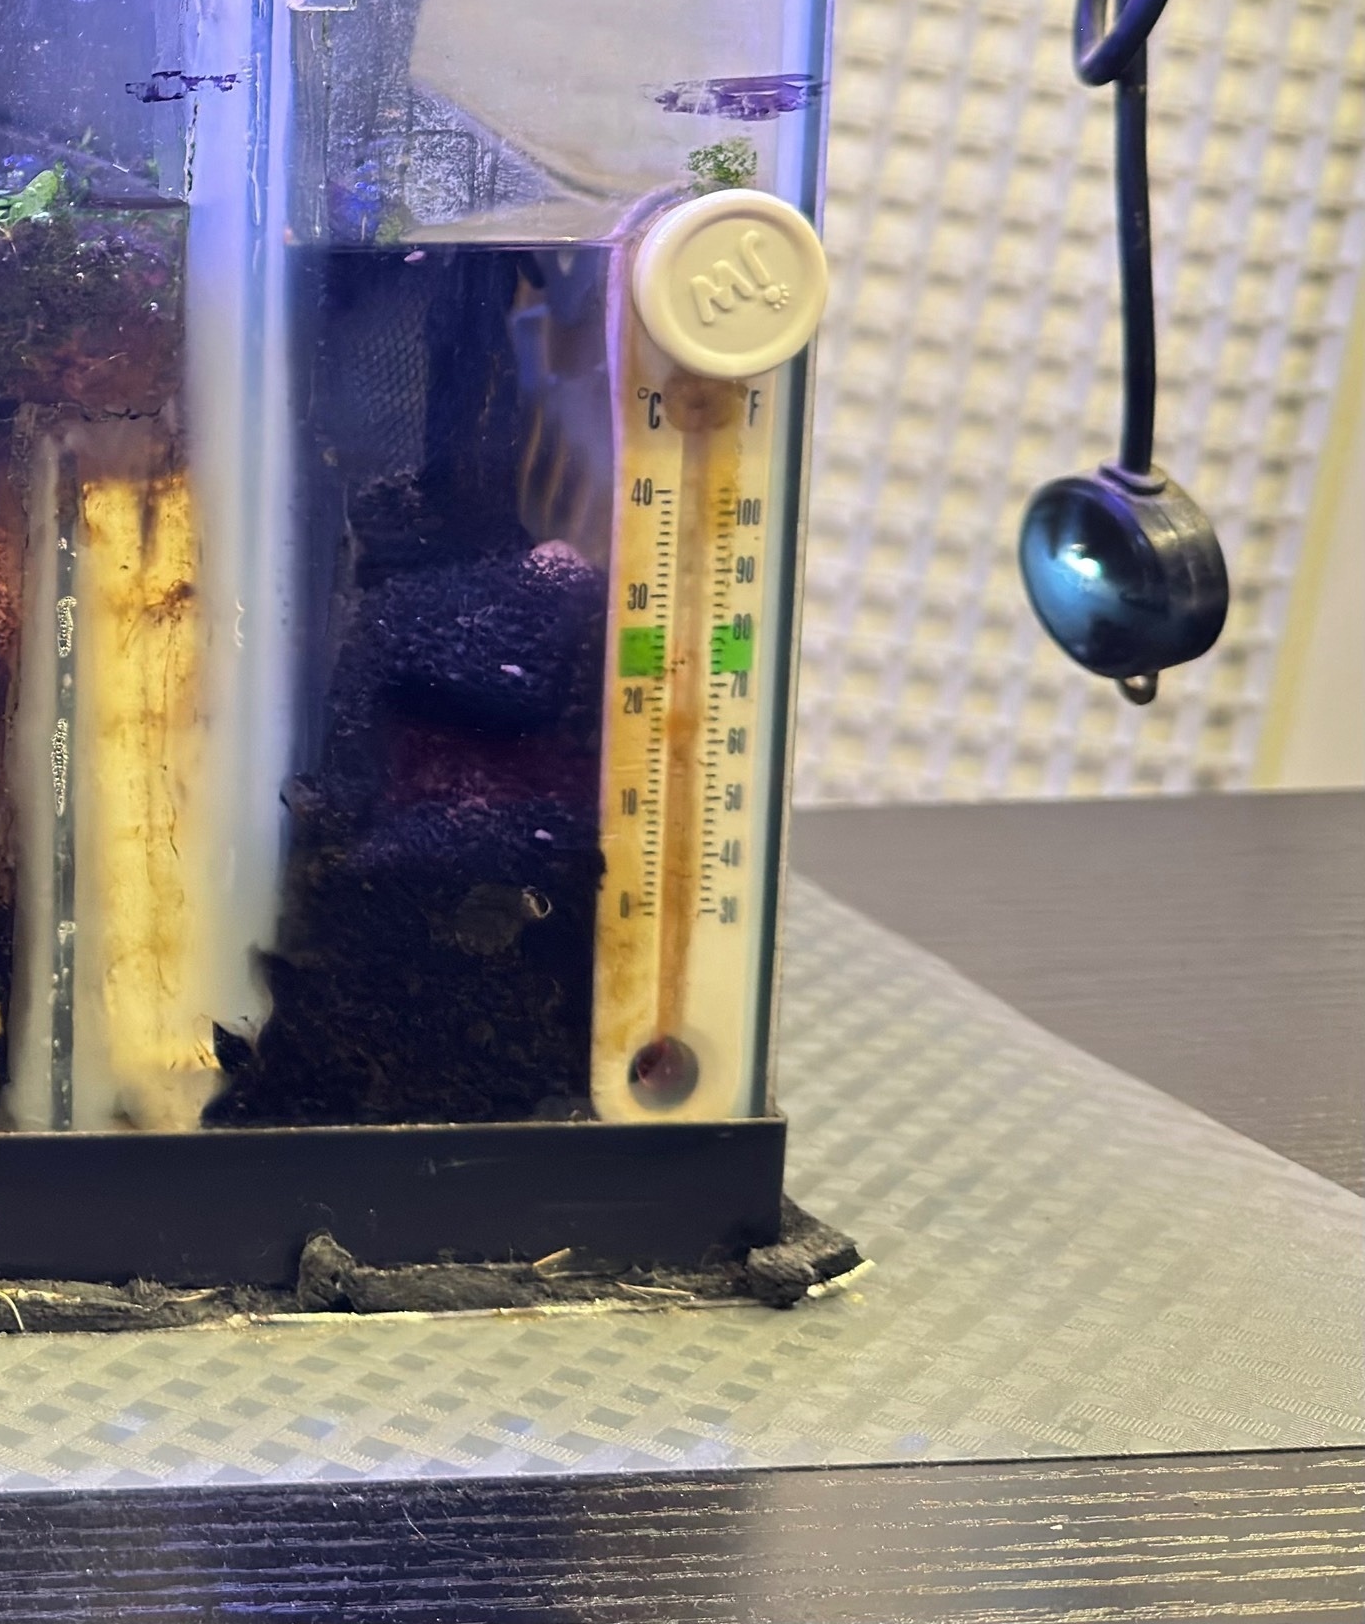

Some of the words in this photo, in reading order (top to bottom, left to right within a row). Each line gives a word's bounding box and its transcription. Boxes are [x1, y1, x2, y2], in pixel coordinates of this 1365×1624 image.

[631, 478, 653, 507] 40
[736, 498, 762, 526] 100
[735, 556, 755, 584] 90
[627, 582, 648, 610] 30
[730, 670, 749, 698] 70
[623, 686, 644, 714] 20
[727, 727, 747, 755] 60
[622, 788, 638, 816] 10
[725, 783, 743, 811] 50
[719, 839, 742, 868] 40
